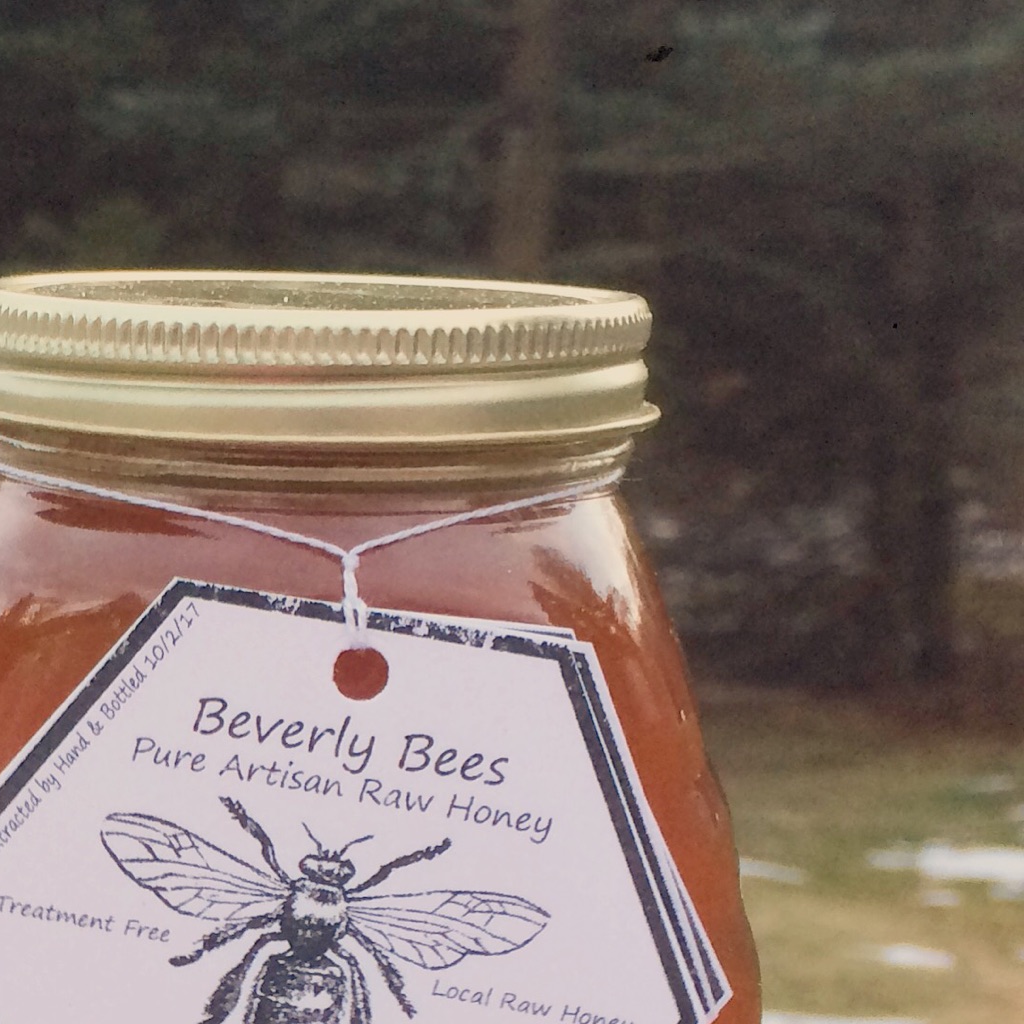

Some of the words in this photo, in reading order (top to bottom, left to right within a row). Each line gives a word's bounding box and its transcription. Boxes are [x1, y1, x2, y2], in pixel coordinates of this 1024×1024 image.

[42, 775, 61, 796] by
[57, 731, 91, 775] Hand
[92, 718, 104, 736] &
[102, 667, 147, 721] Bottled
[144, 603, 200, 669] 10/2/17
[193, 696, 376, 774] Beverly
[399, 733, 510, 786] Bees
[132, 737, 206, 772] Pure
[219, 754, 342, 798] Artisan
[359, 777, 435, 812] Raw
[447, 794, 554, 845] Honey
[124, 919, 170, 942] Free
[431, 979, 493, 1006] Local
[500, 992, 552, 1017] Raw
